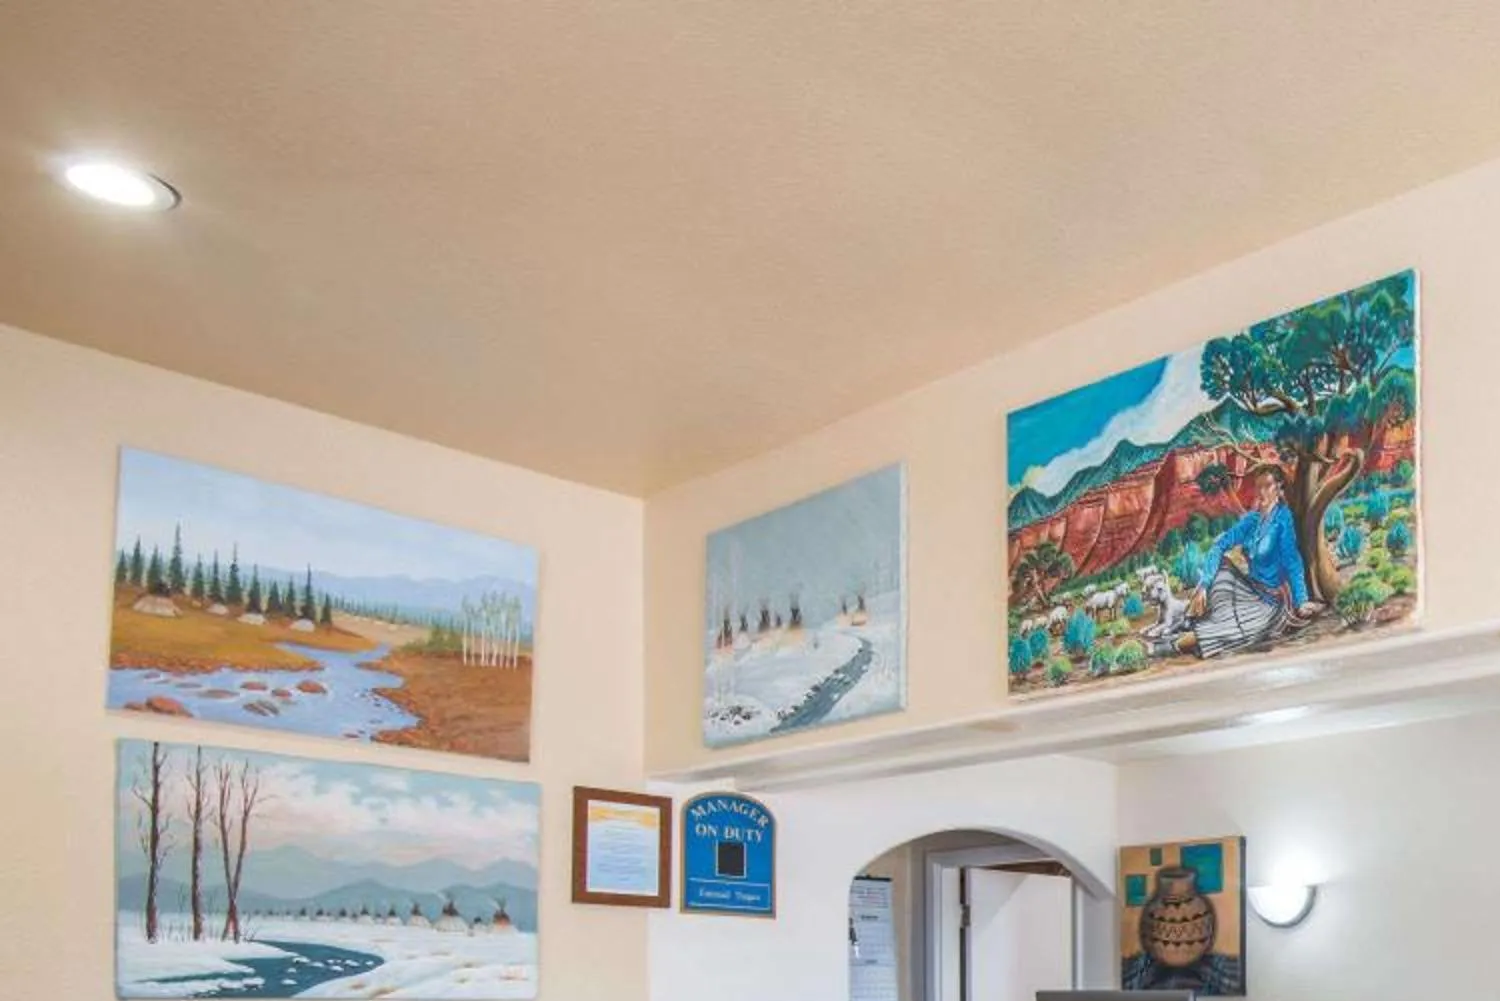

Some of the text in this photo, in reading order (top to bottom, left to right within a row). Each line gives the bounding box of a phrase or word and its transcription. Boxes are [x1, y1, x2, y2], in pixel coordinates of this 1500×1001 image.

[690, 799, 769, 828] MANAGER
[695, 823, 764, 843] ON DUTY
